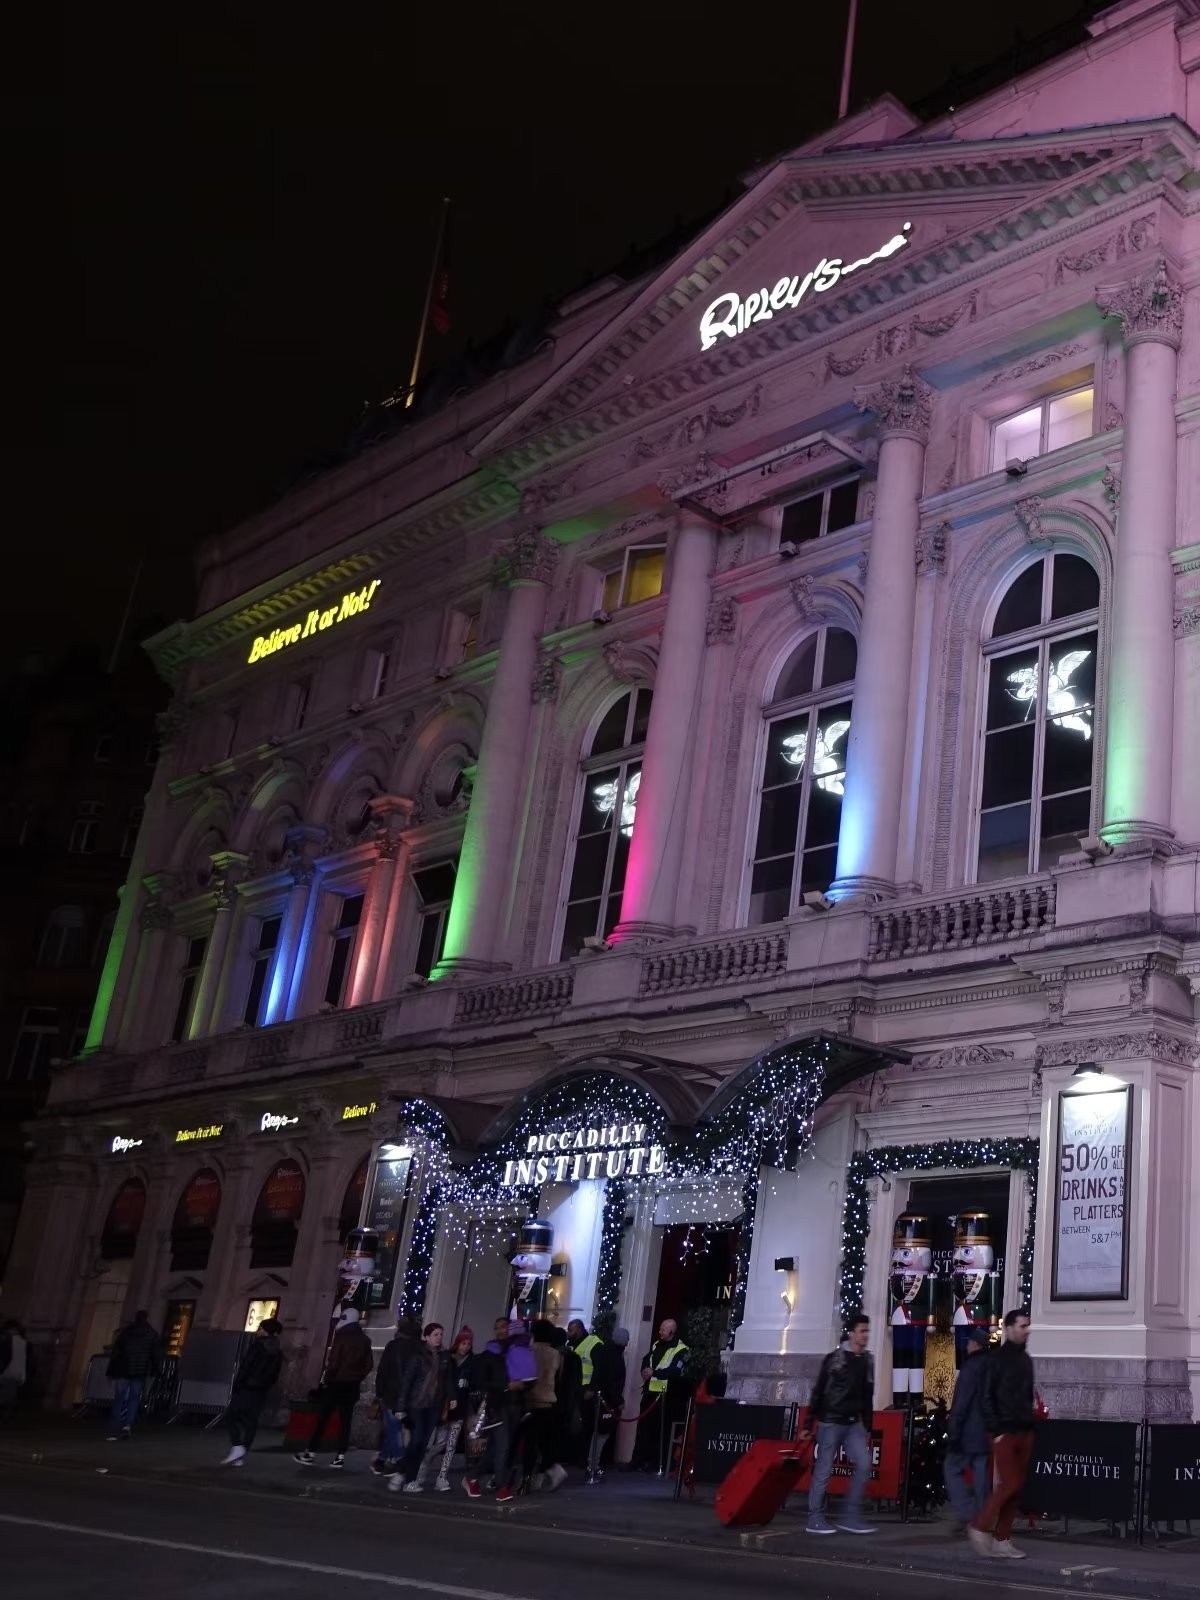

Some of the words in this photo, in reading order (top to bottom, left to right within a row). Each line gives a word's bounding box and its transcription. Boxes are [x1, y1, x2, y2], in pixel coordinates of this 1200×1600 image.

[248, 624, 301, 663] Believe
[301, 609, 319, 638] It
[319, 606, 338, 630] or
[337, 580, 376, 622] Not!
[526, 1124, 646, 1152] PICCADILLY
[501, 1146, 665, 1186] INSTITUTE
[1061, 1143, 1108, 1173] 50%
[1113, 1159, 1125, 1170] ALL
[1062, 1176, 1118, 1201] DRINKS
[1073, 1204, 1124, 1221] PLATTERS
[1062, 1226, 1091, 1235] BETWEEN
[708, 1440, 753, 1452] INSTITU
[1054, 1453, 1104, 1464] PICCADILLY
[1035, 1461, 1120, 1479] INSTITUTE
